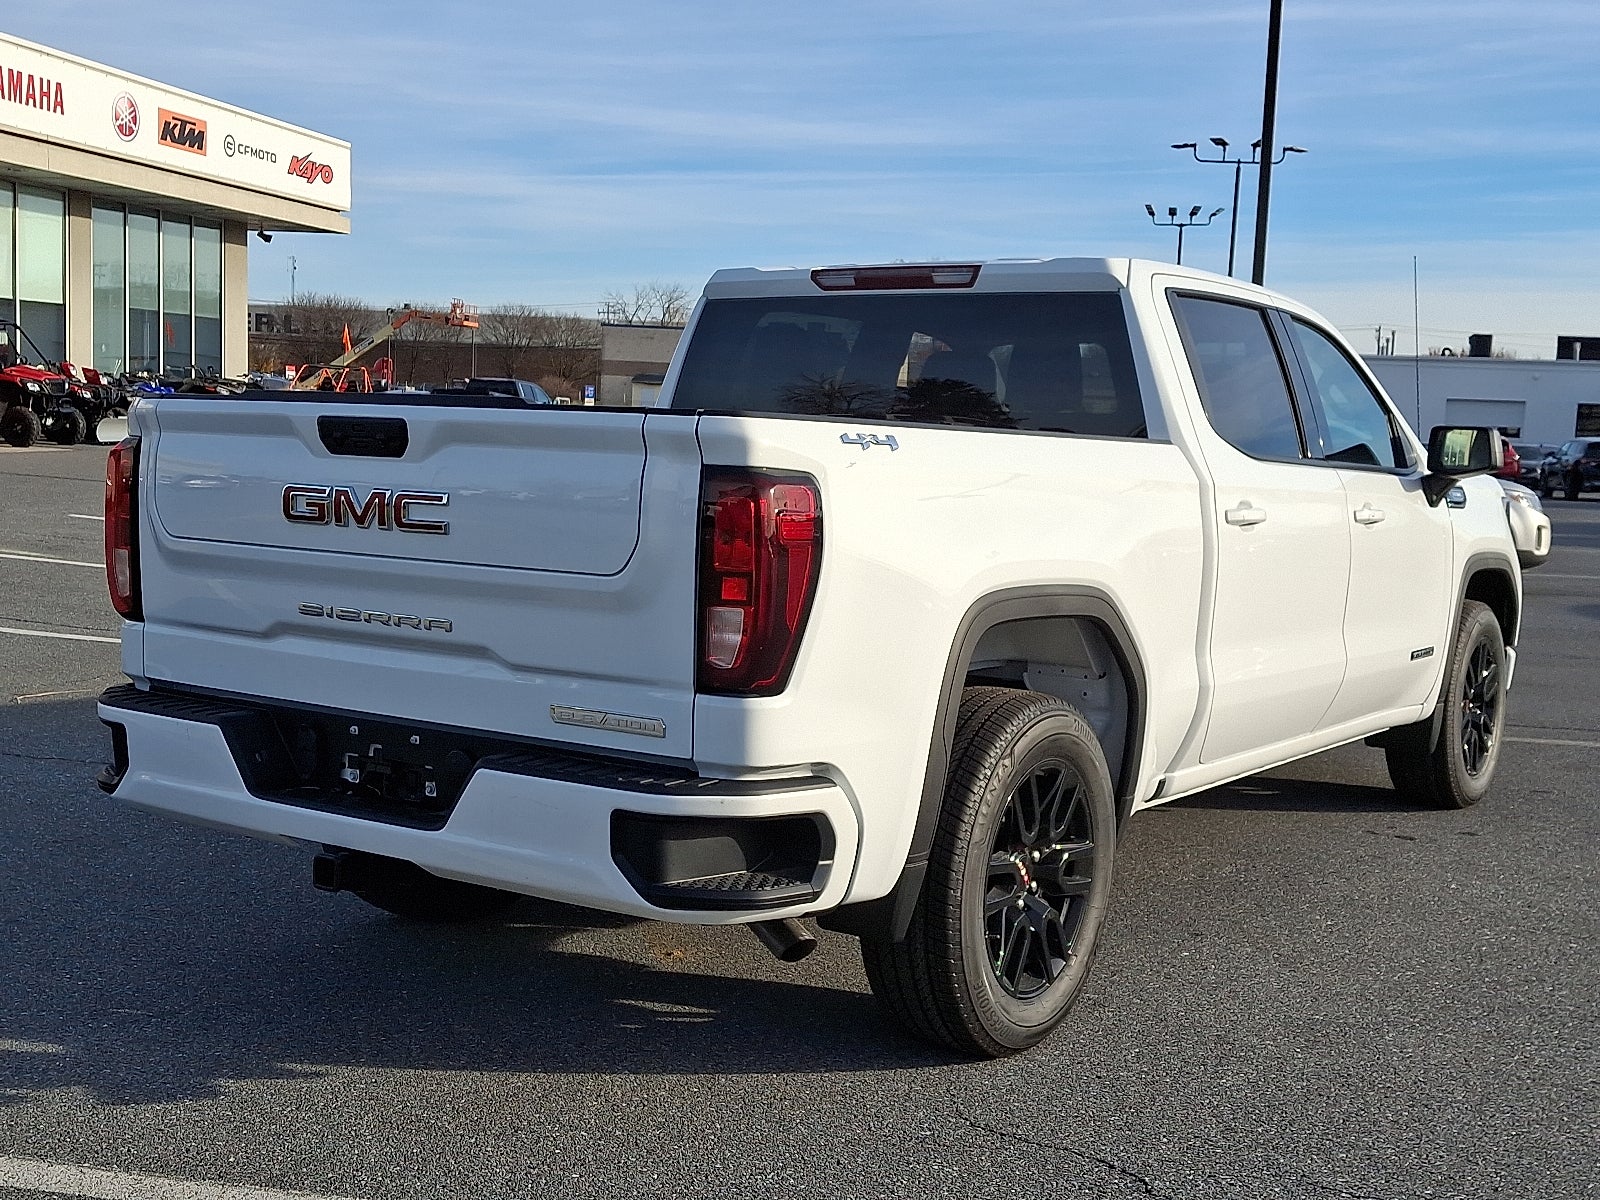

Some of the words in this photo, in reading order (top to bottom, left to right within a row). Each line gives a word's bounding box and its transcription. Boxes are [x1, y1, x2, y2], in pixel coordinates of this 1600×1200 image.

[160, 116, 205, 151] KTM
[238, 143, 277, 163] CFMOTO
[287, 152, 333, 184] KAYO
[281, 483, 450, 535] GMC
[298, 601, 453, 633] SIERRA
